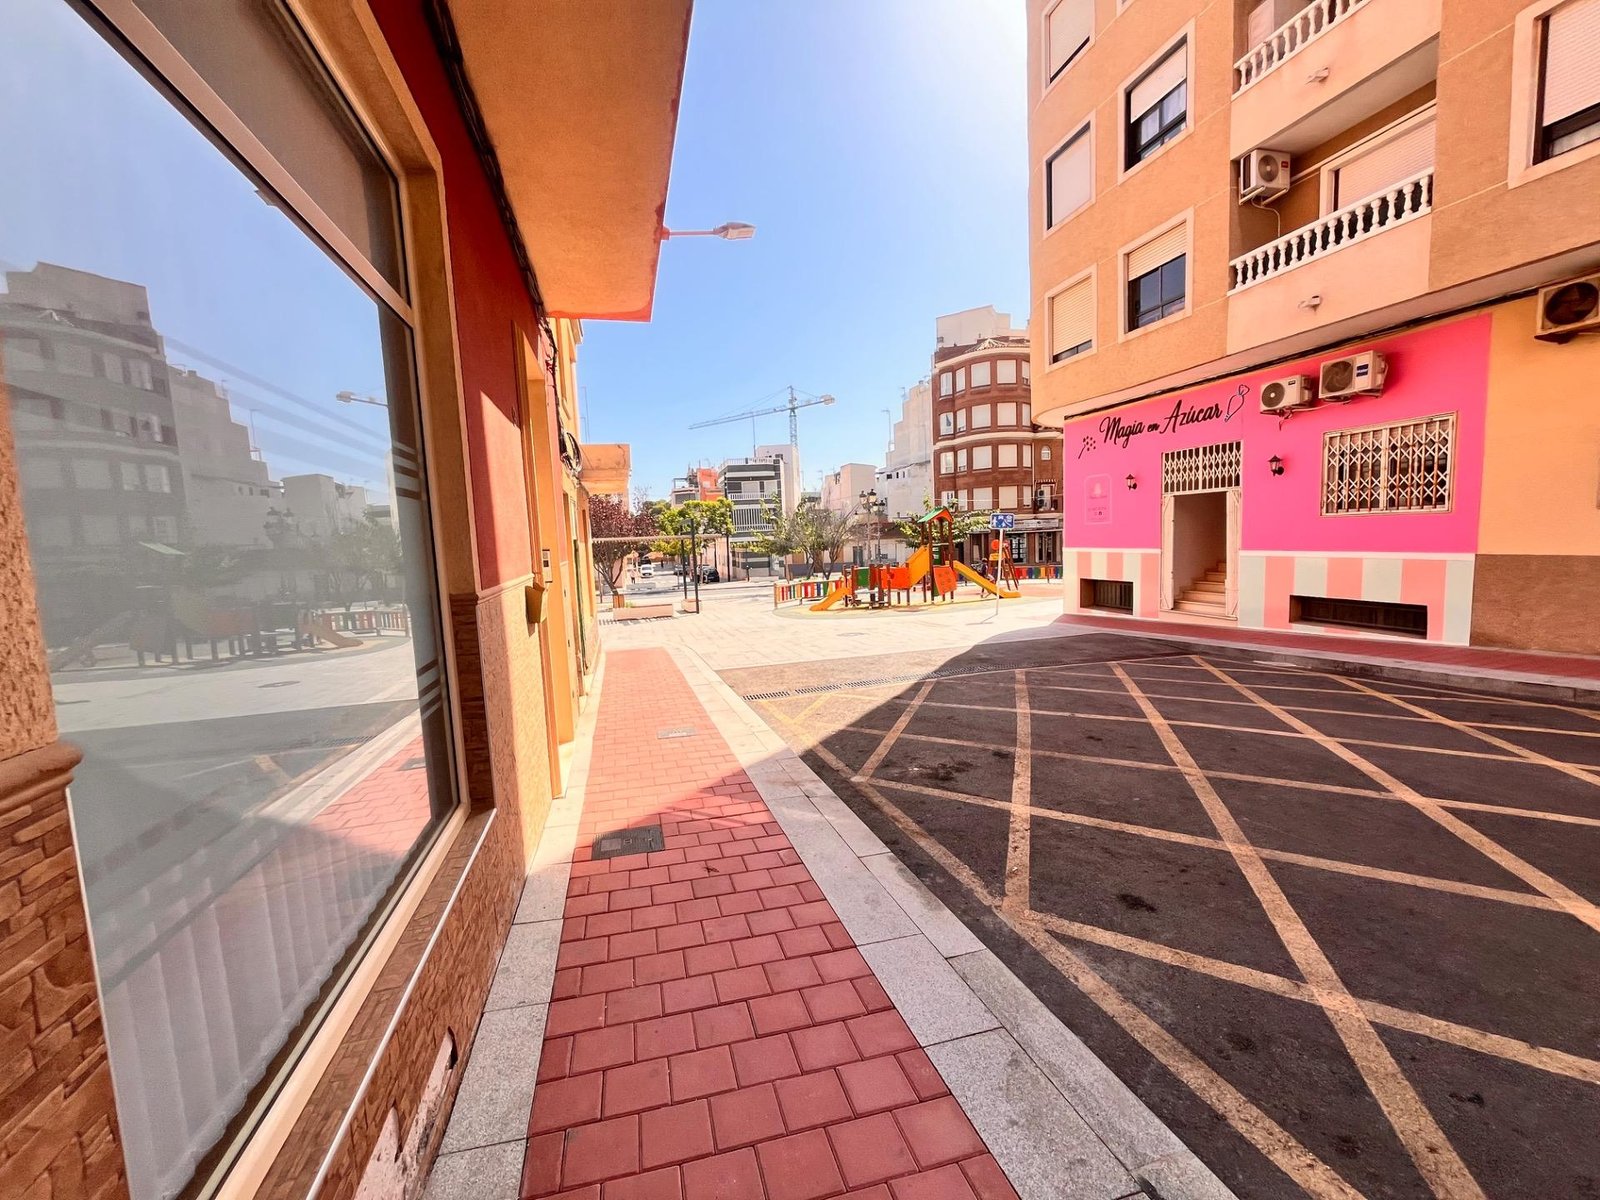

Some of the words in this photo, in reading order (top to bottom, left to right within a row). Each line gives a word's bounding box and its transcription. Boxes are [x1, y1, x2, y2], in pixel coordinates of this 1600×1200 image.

[1099, 416, 1145, 448] Magia
[1147, 423, 1160, 433] en
[1160, 400, 1223, 434] Azúcar
